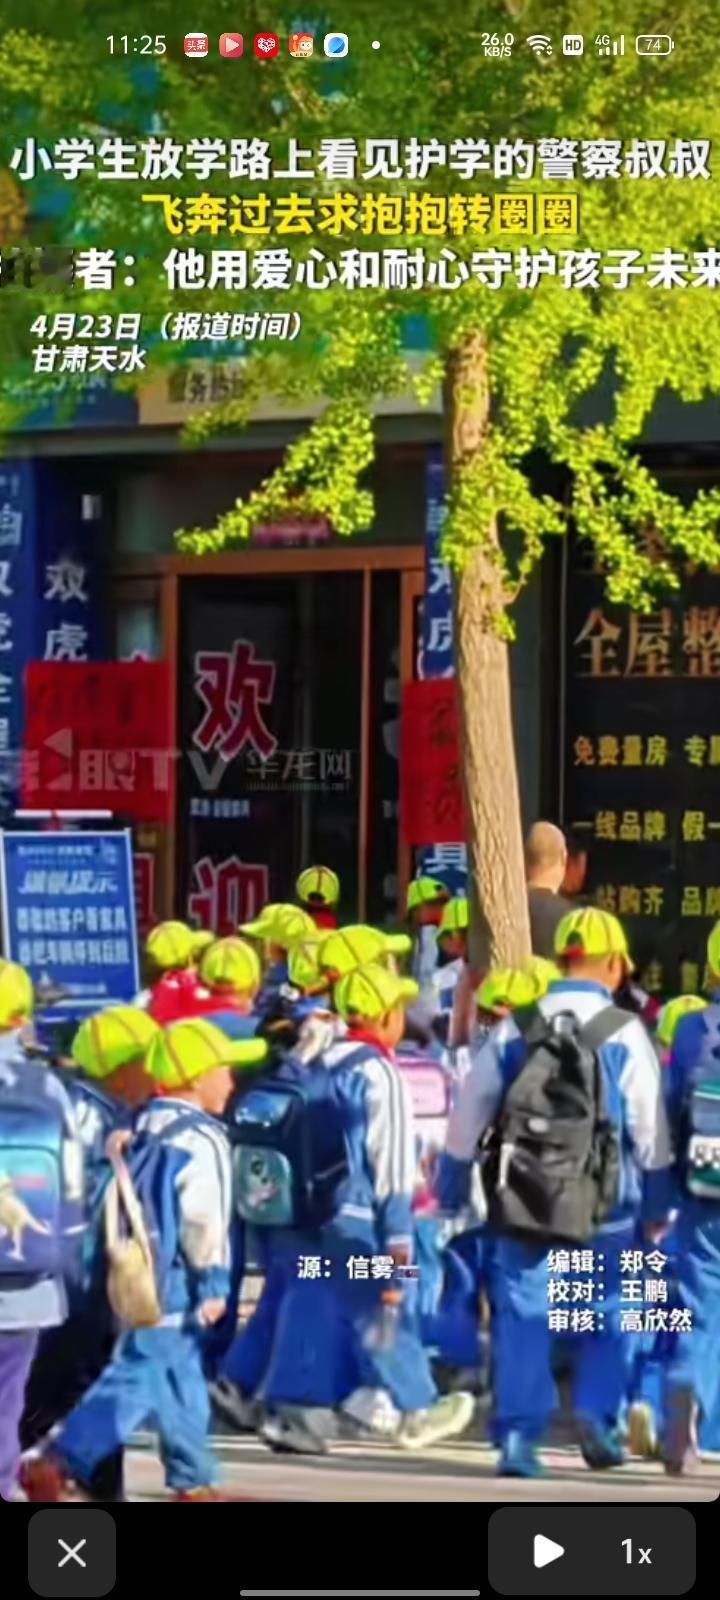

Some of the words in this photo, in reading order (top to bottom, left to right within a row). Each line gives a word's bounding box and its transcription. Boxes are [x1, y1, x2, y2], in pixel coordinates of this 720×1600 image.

[573, 735, 668, 767] 免费量房
[572, 810, 666, 841] 一线品牌
